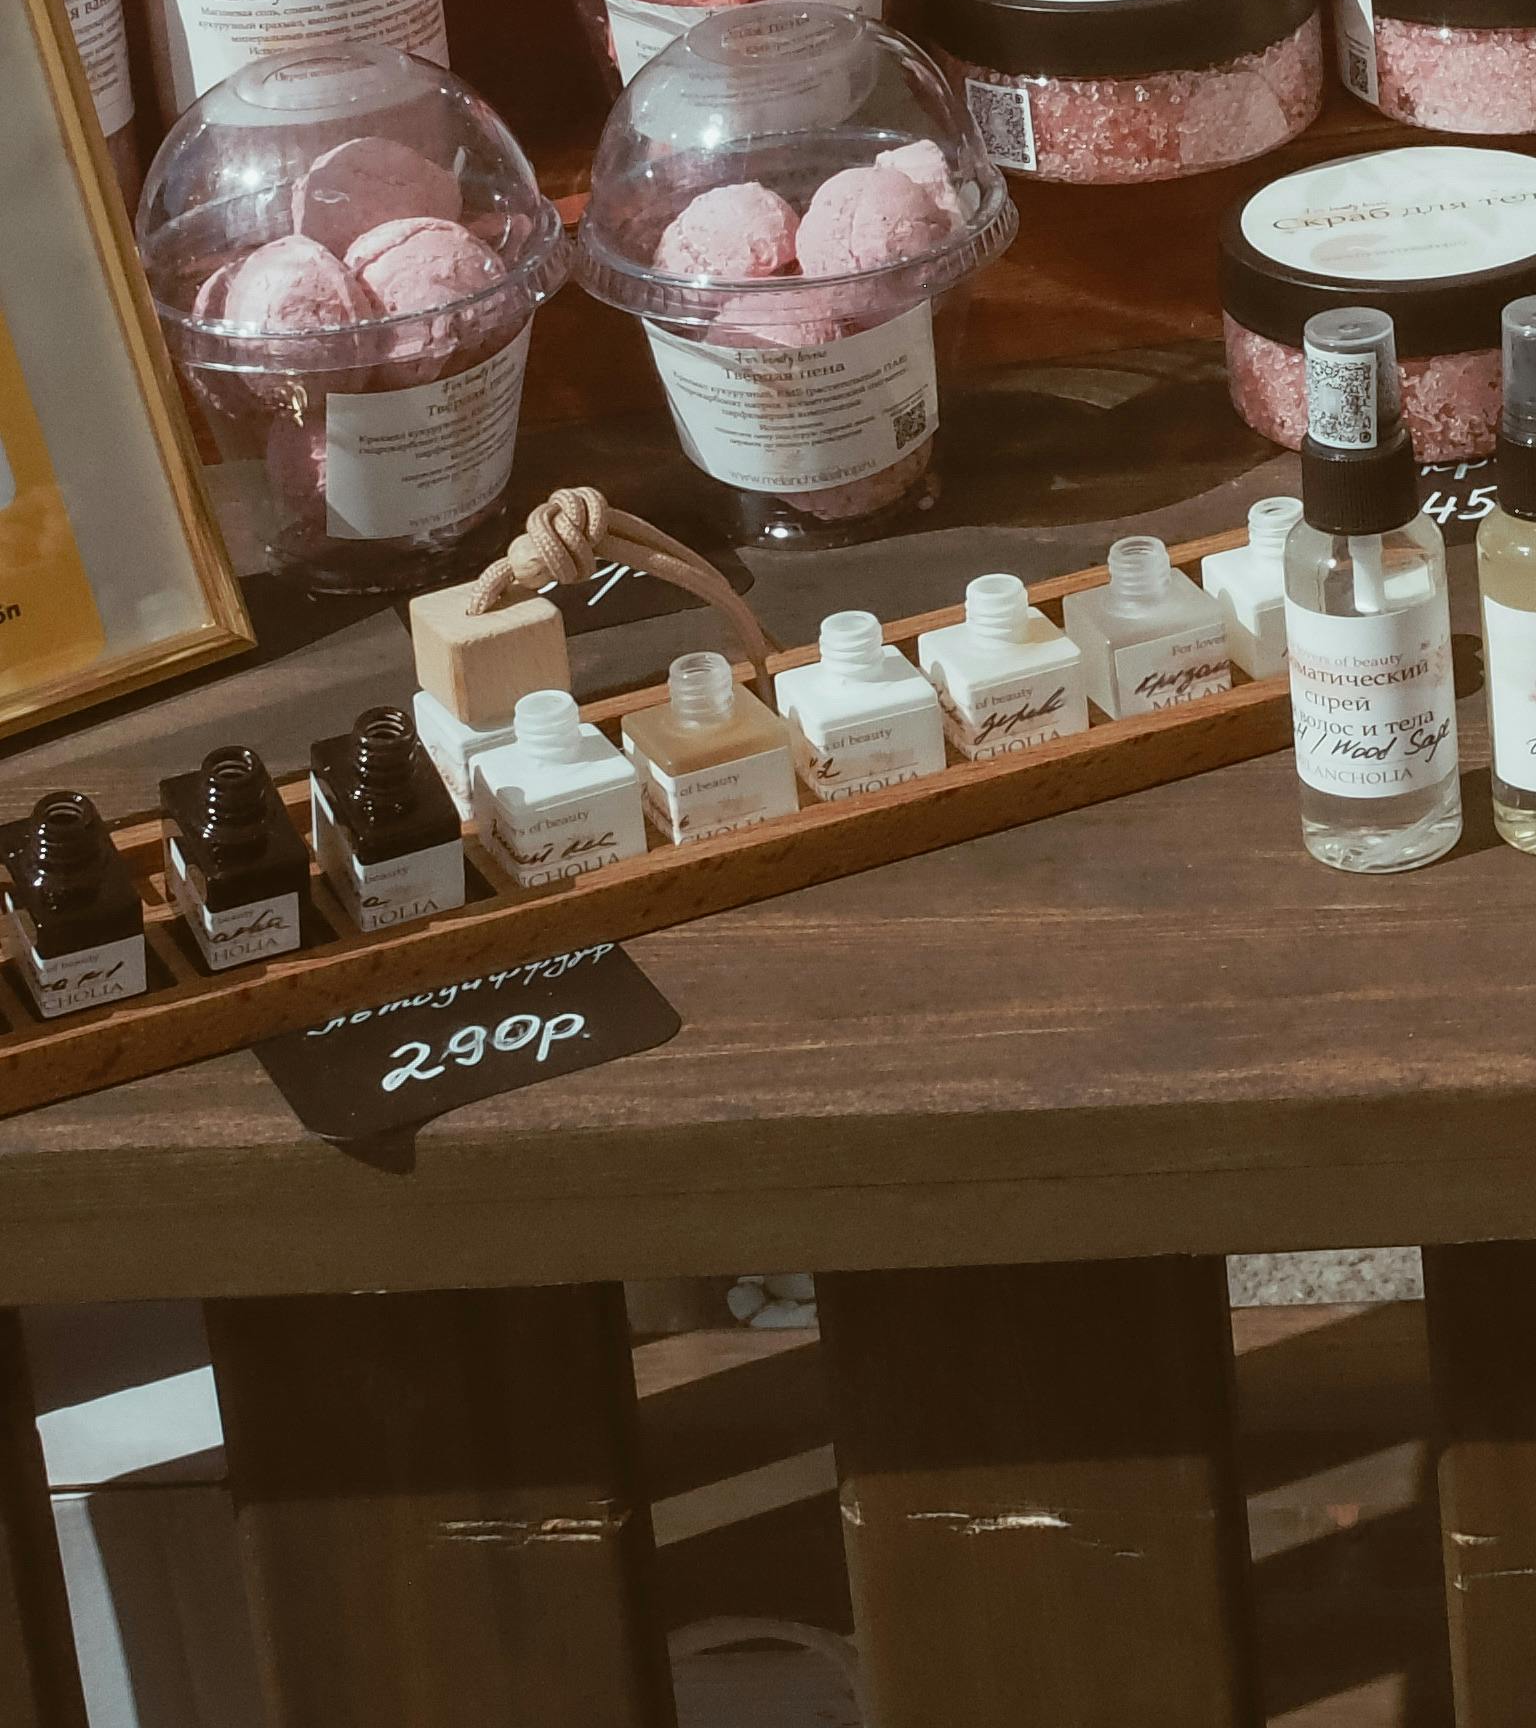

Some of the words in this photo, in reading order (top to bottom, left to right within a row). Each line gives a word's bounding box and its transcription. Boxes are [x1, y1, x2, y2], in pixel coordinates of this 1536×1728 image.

[1273, 205, 1391, 232] Скраб
[1402, 201, 1467, 216] для
[991, 687, 1033, 705] beauty
[1303, 691, 1371, 716] спрей
[1361, 723, 1378, 738] и
[1384, 710, 1435, 734] тела
[849, 728, 893, 747] beauty
[1331, 738, 1397, 761] Wood
[696, 773, 740, 791] beauty
[546, 810, 590, 827] beauty
